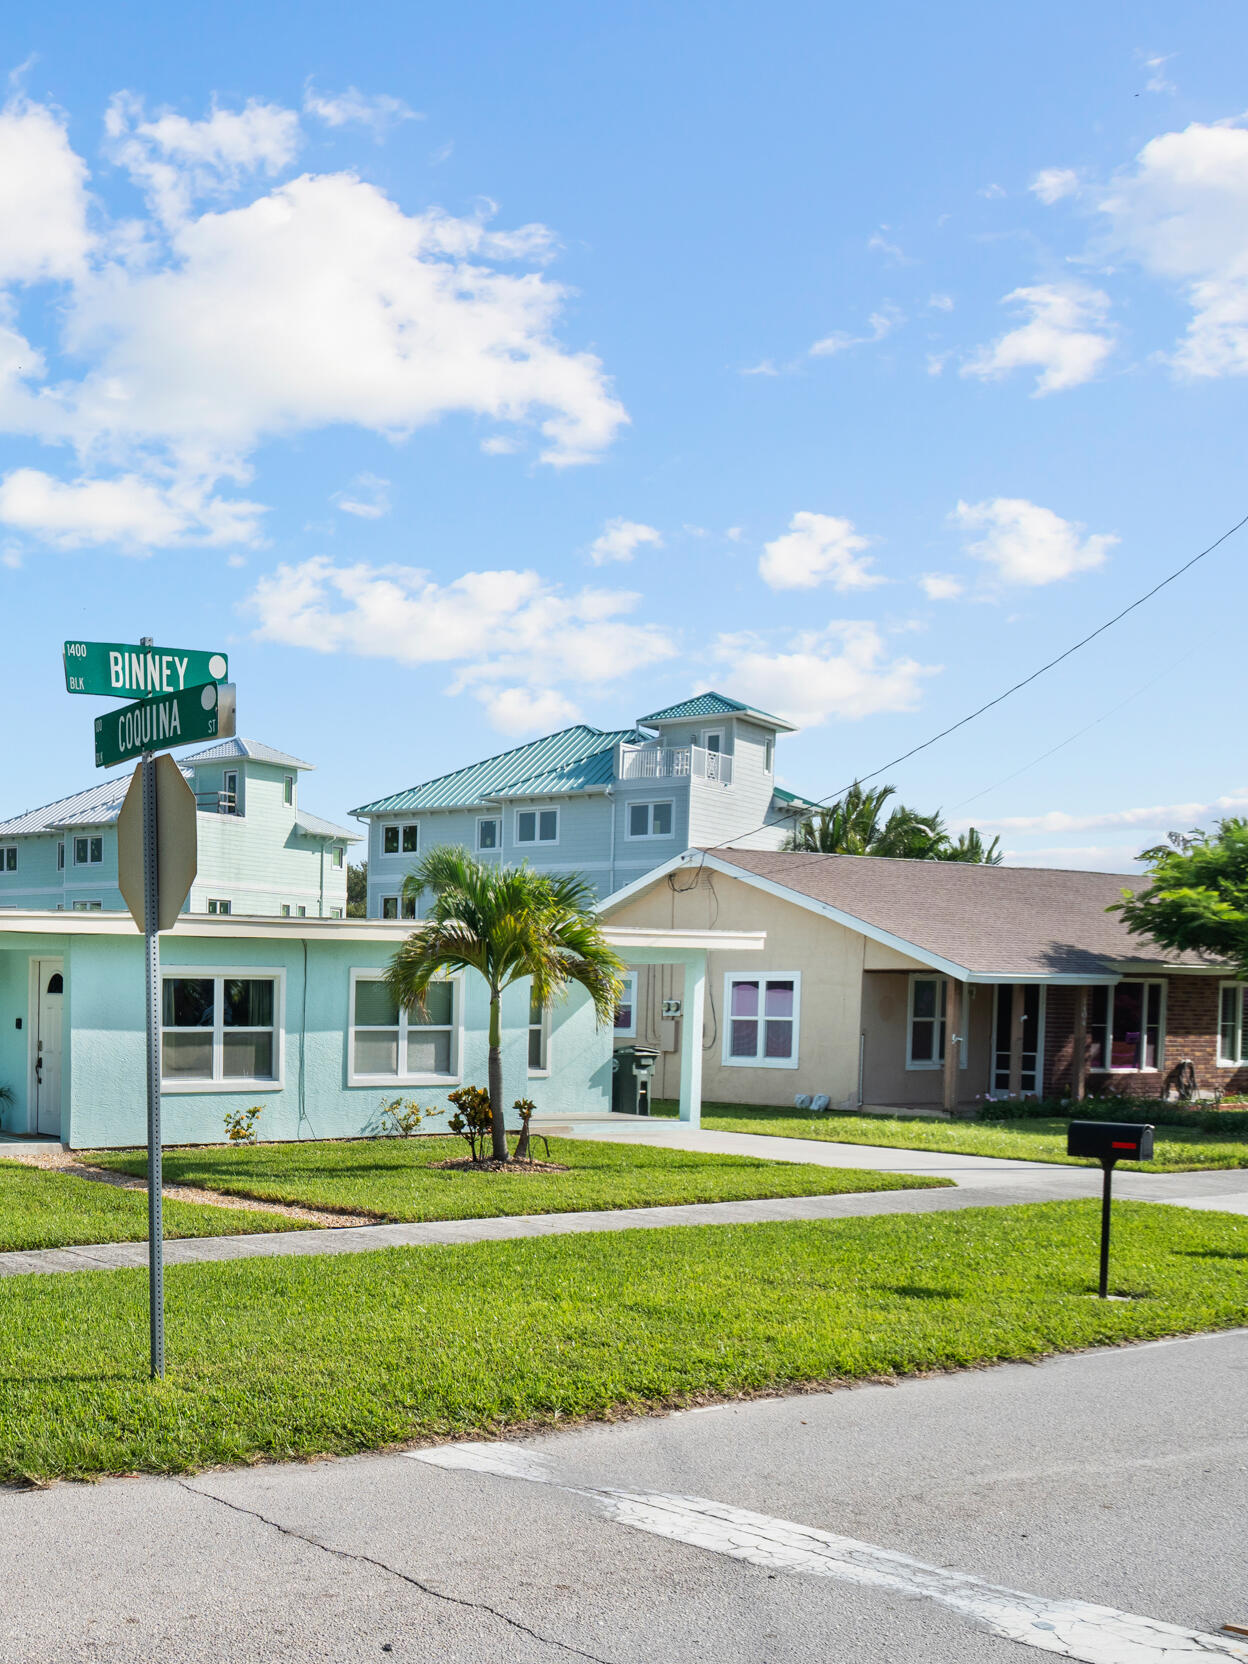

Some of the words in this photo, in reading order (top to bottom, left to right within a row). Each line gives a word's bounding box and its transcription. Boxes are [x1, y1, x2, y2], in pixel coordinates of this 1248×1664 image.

[67, 644, 87, 657] 1400
[109, 651, 189, 692] BINNEY
[70, 677, 85, 690] BLK
[118, 699, 181, 752] COQUINA
[208, 720, 216, 734] ST
